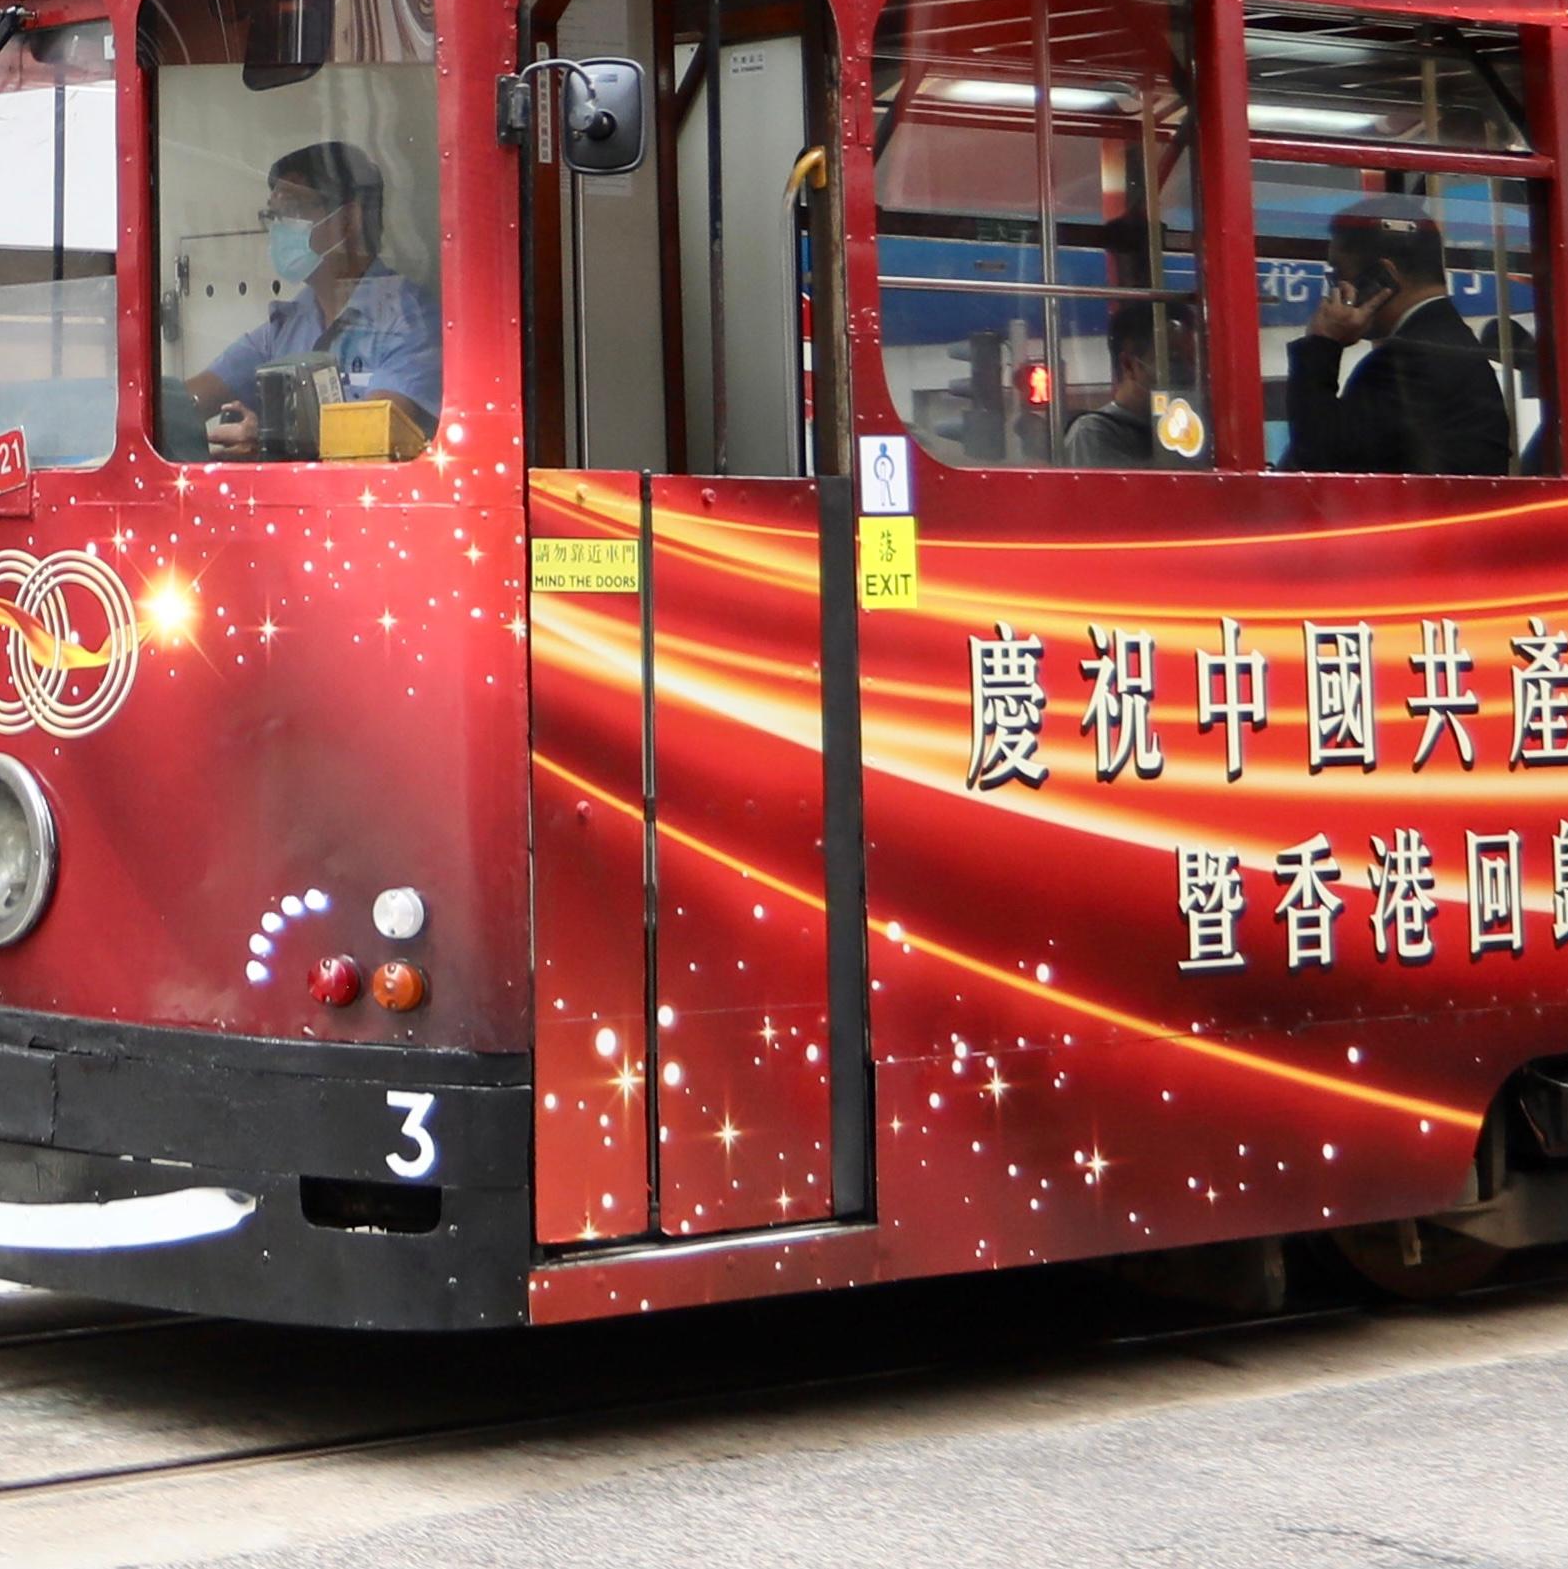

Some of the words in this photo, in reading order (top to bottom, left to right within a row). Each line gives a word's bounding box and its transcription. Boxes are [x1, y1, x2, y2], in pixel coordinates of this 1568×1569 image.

[534, 543, 636, 564] 請勿靠近車門
[535, 575, 566, 588] MIND
[569, 575, 592, 588] THE
[595, 575, 636, 588] DOORS
[865, 573, 912, 597] EXIT
[385, 1090, 438, 1180] 3
